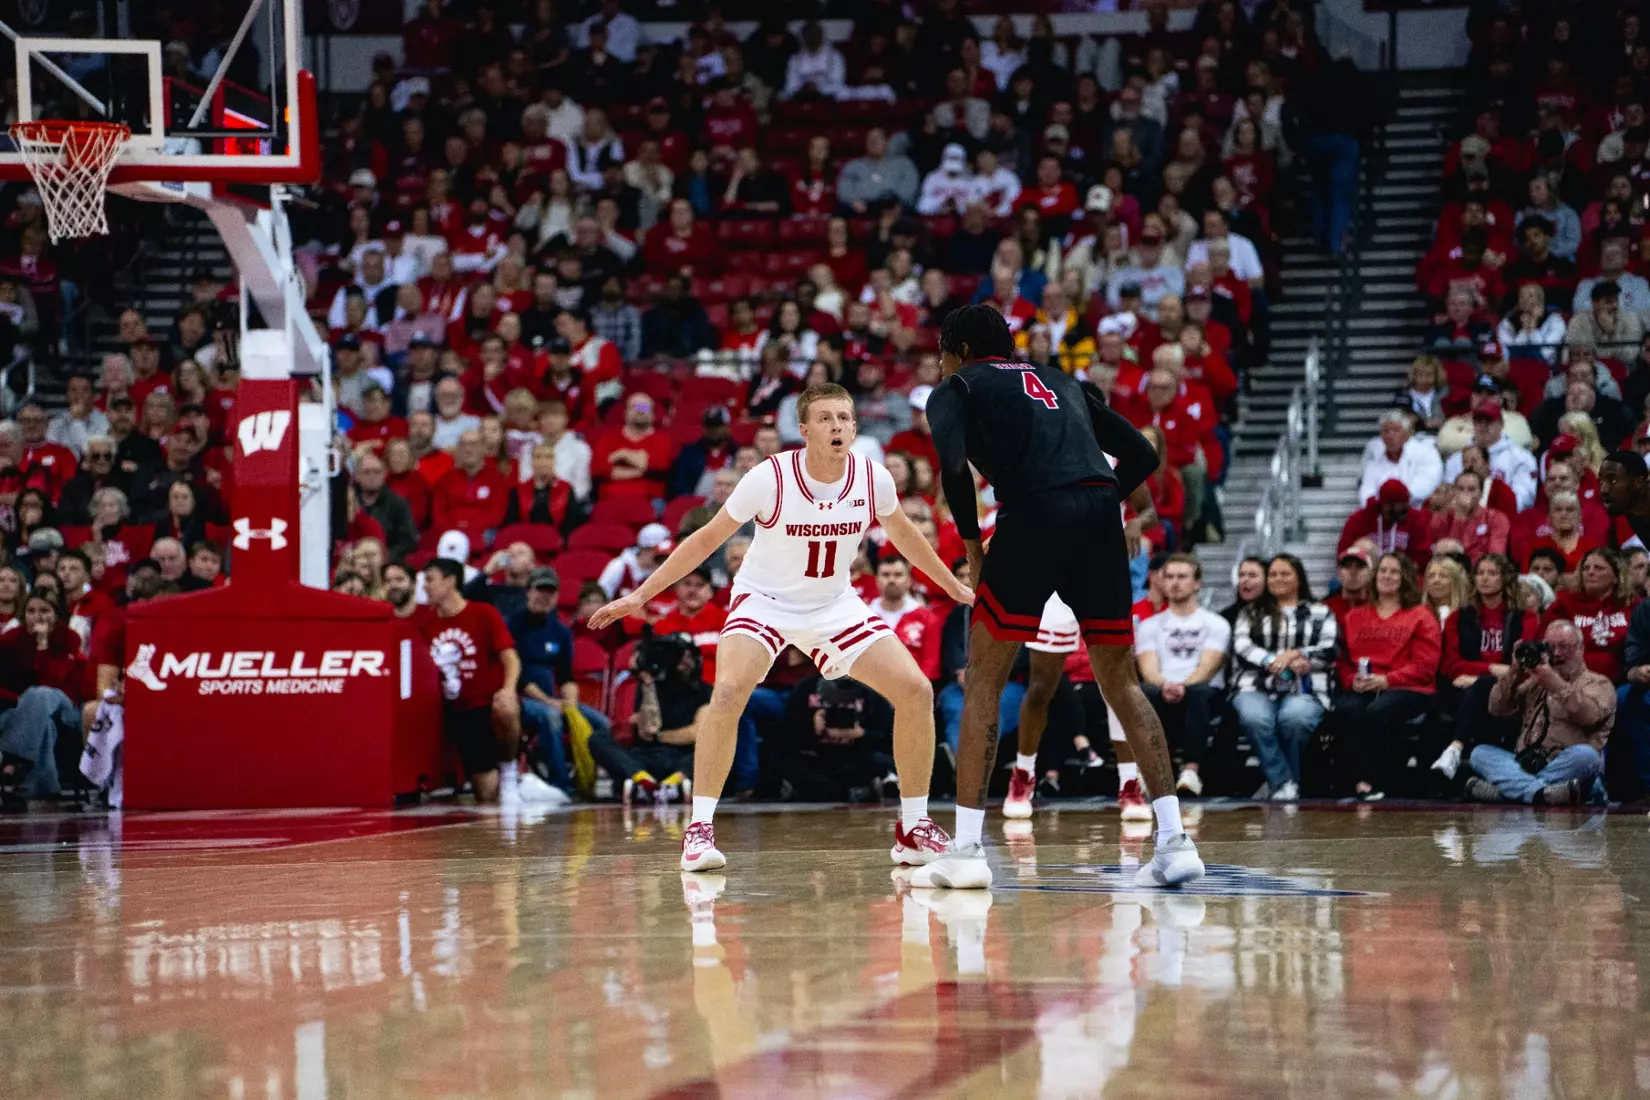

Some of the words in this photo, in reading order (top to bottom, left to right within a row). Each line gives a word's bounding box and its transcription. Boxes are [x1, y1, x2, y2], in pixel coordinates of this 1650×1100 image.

[1021, 371, 1060, 409] 4
[237, 410, 292, 457] W
[785, 521, 863, 537] WISCONSIN
[804, 541, 838, 578] 11
[159, 650, 386, 678] MUELLER
[198, 679, 263, 695] SPORTS
[266, 679, 344, 694] MEDICINE
